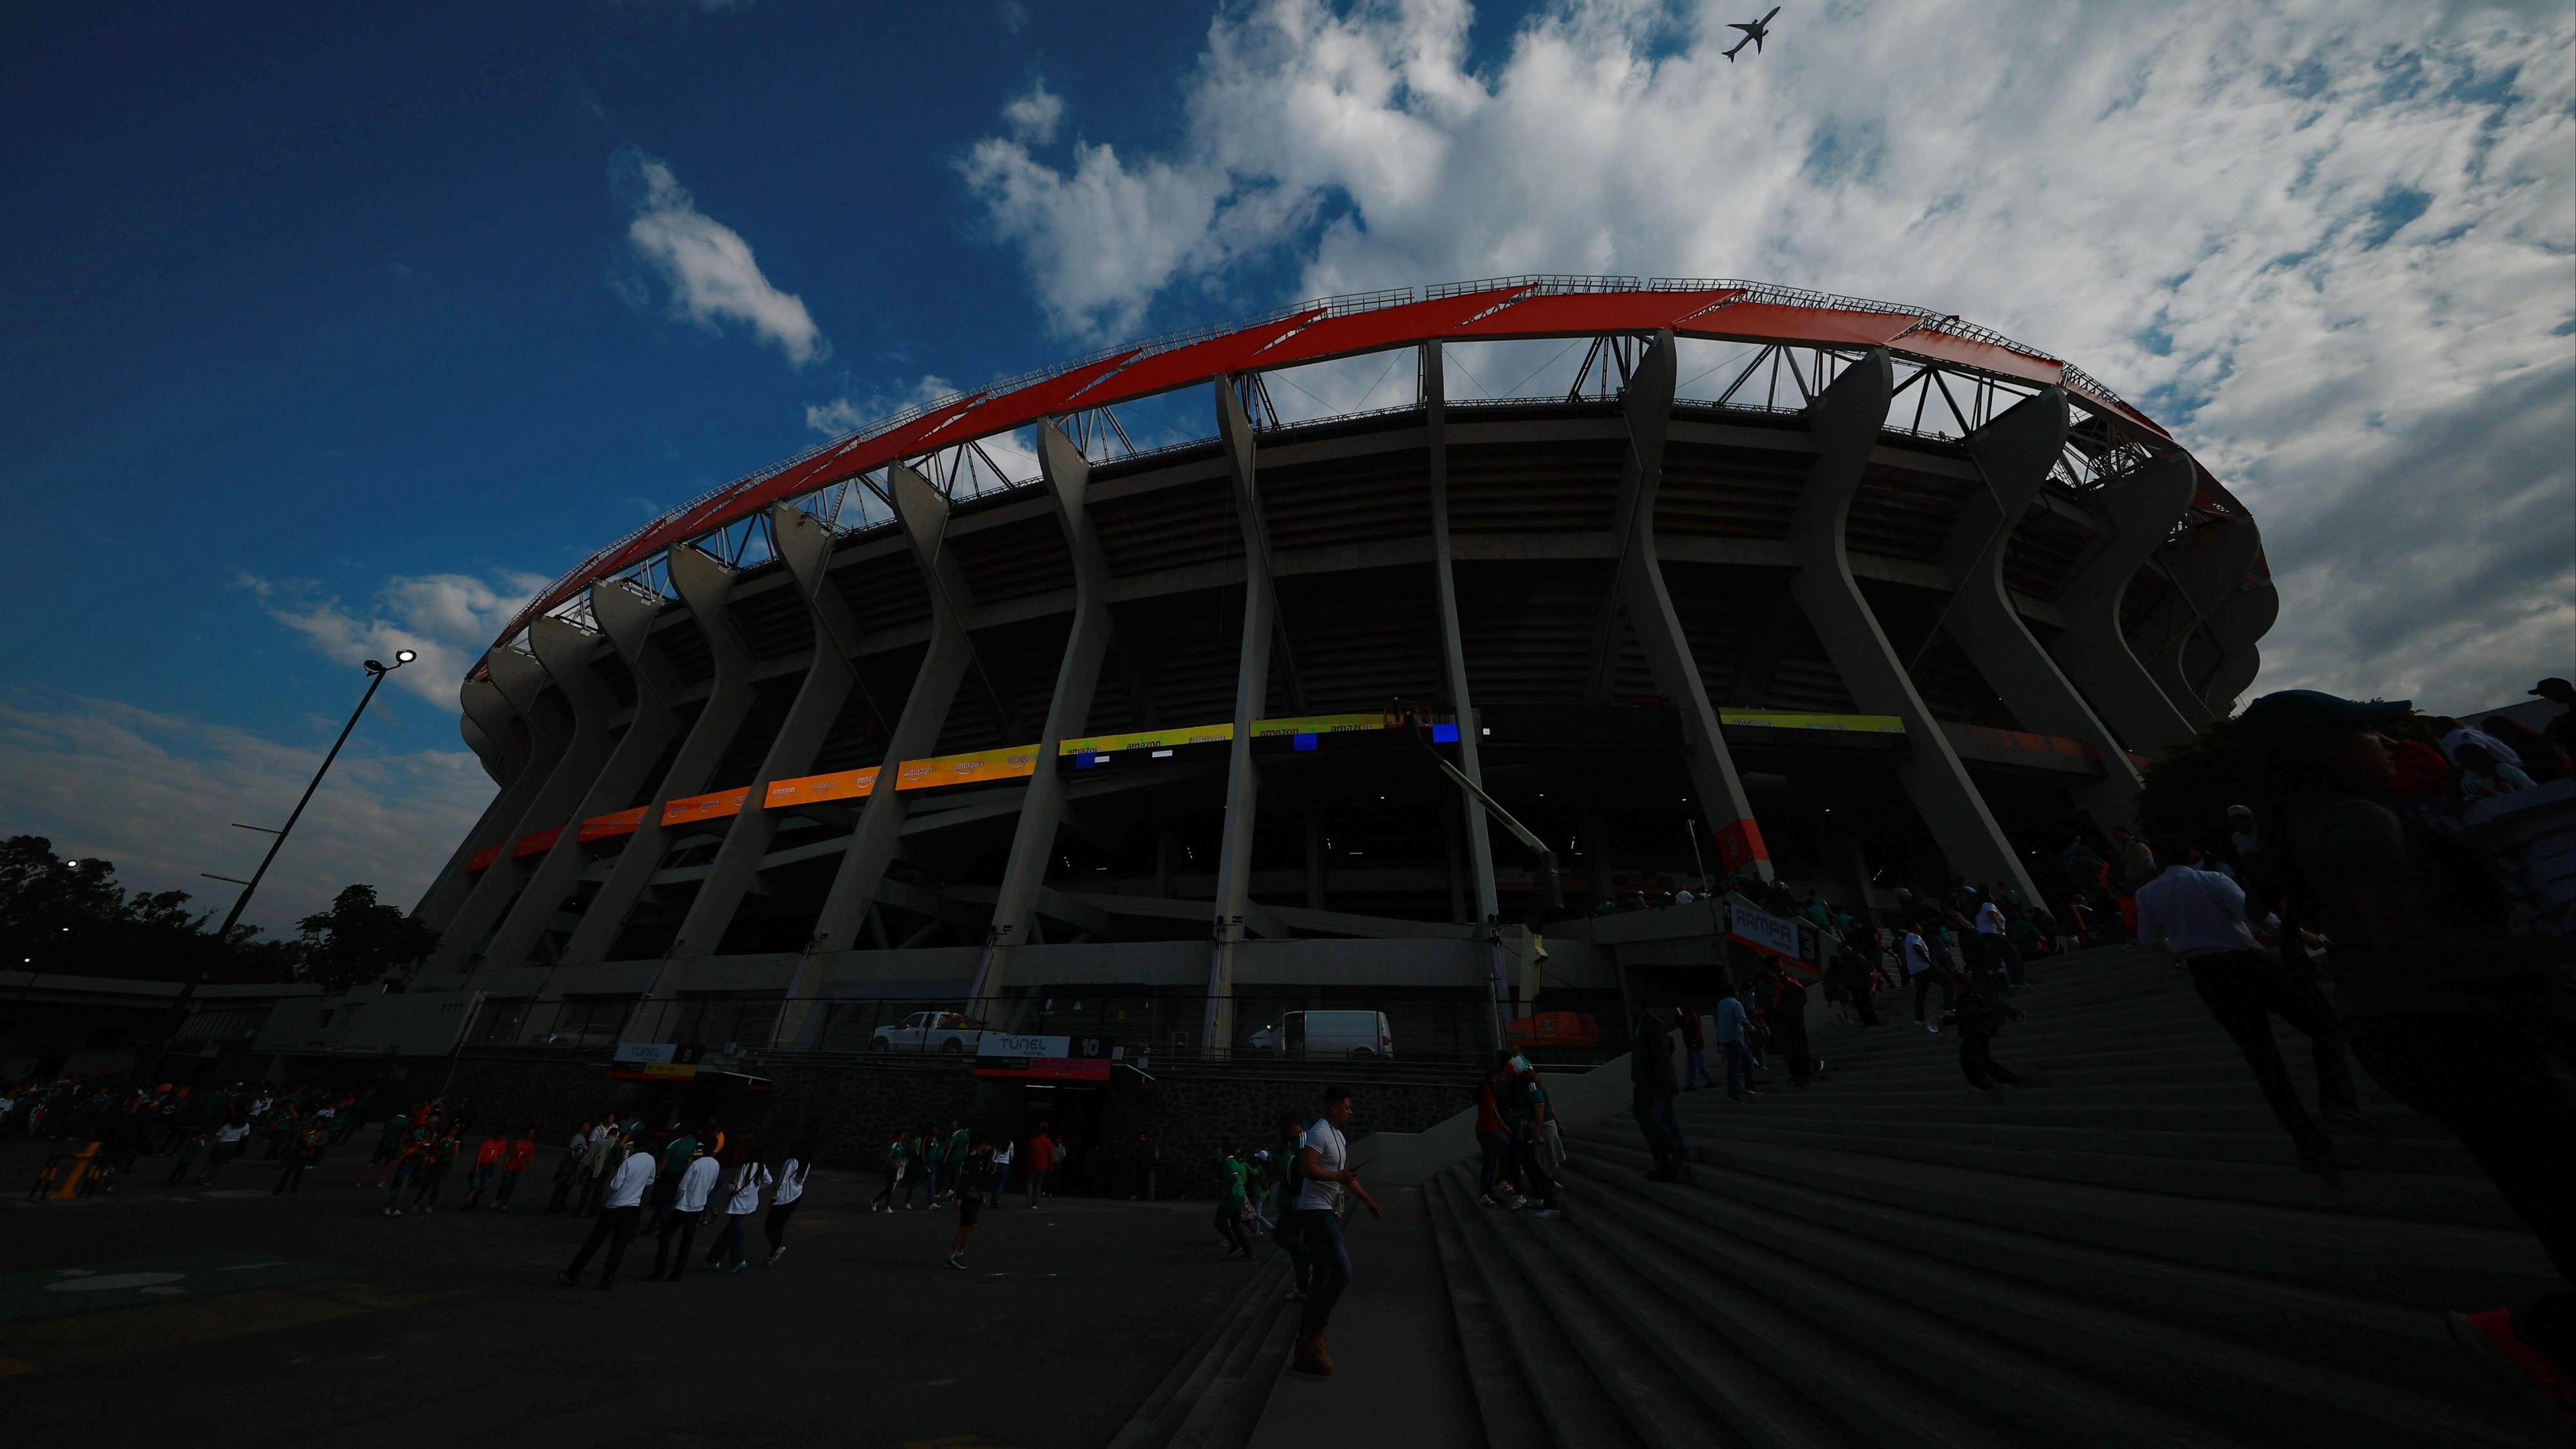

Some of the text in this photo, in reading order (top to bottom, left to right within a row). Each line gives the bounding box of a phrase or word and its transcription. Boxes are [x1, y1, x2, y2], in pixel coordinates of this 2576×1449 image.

[1260, 728, 1298, 737] amazon
[1126, 740, 1161, 750] amazon
[954, 761, 984, 771] amazon
[904, 767, 933, 777] amazon
[772, 786, 796, 795] amazon
[1735, 908, 1792, 943] RAMPA
[1001, 1036, 1046, 1051] TÚNEL
[1081, 1038, 1100, 1057] 10
